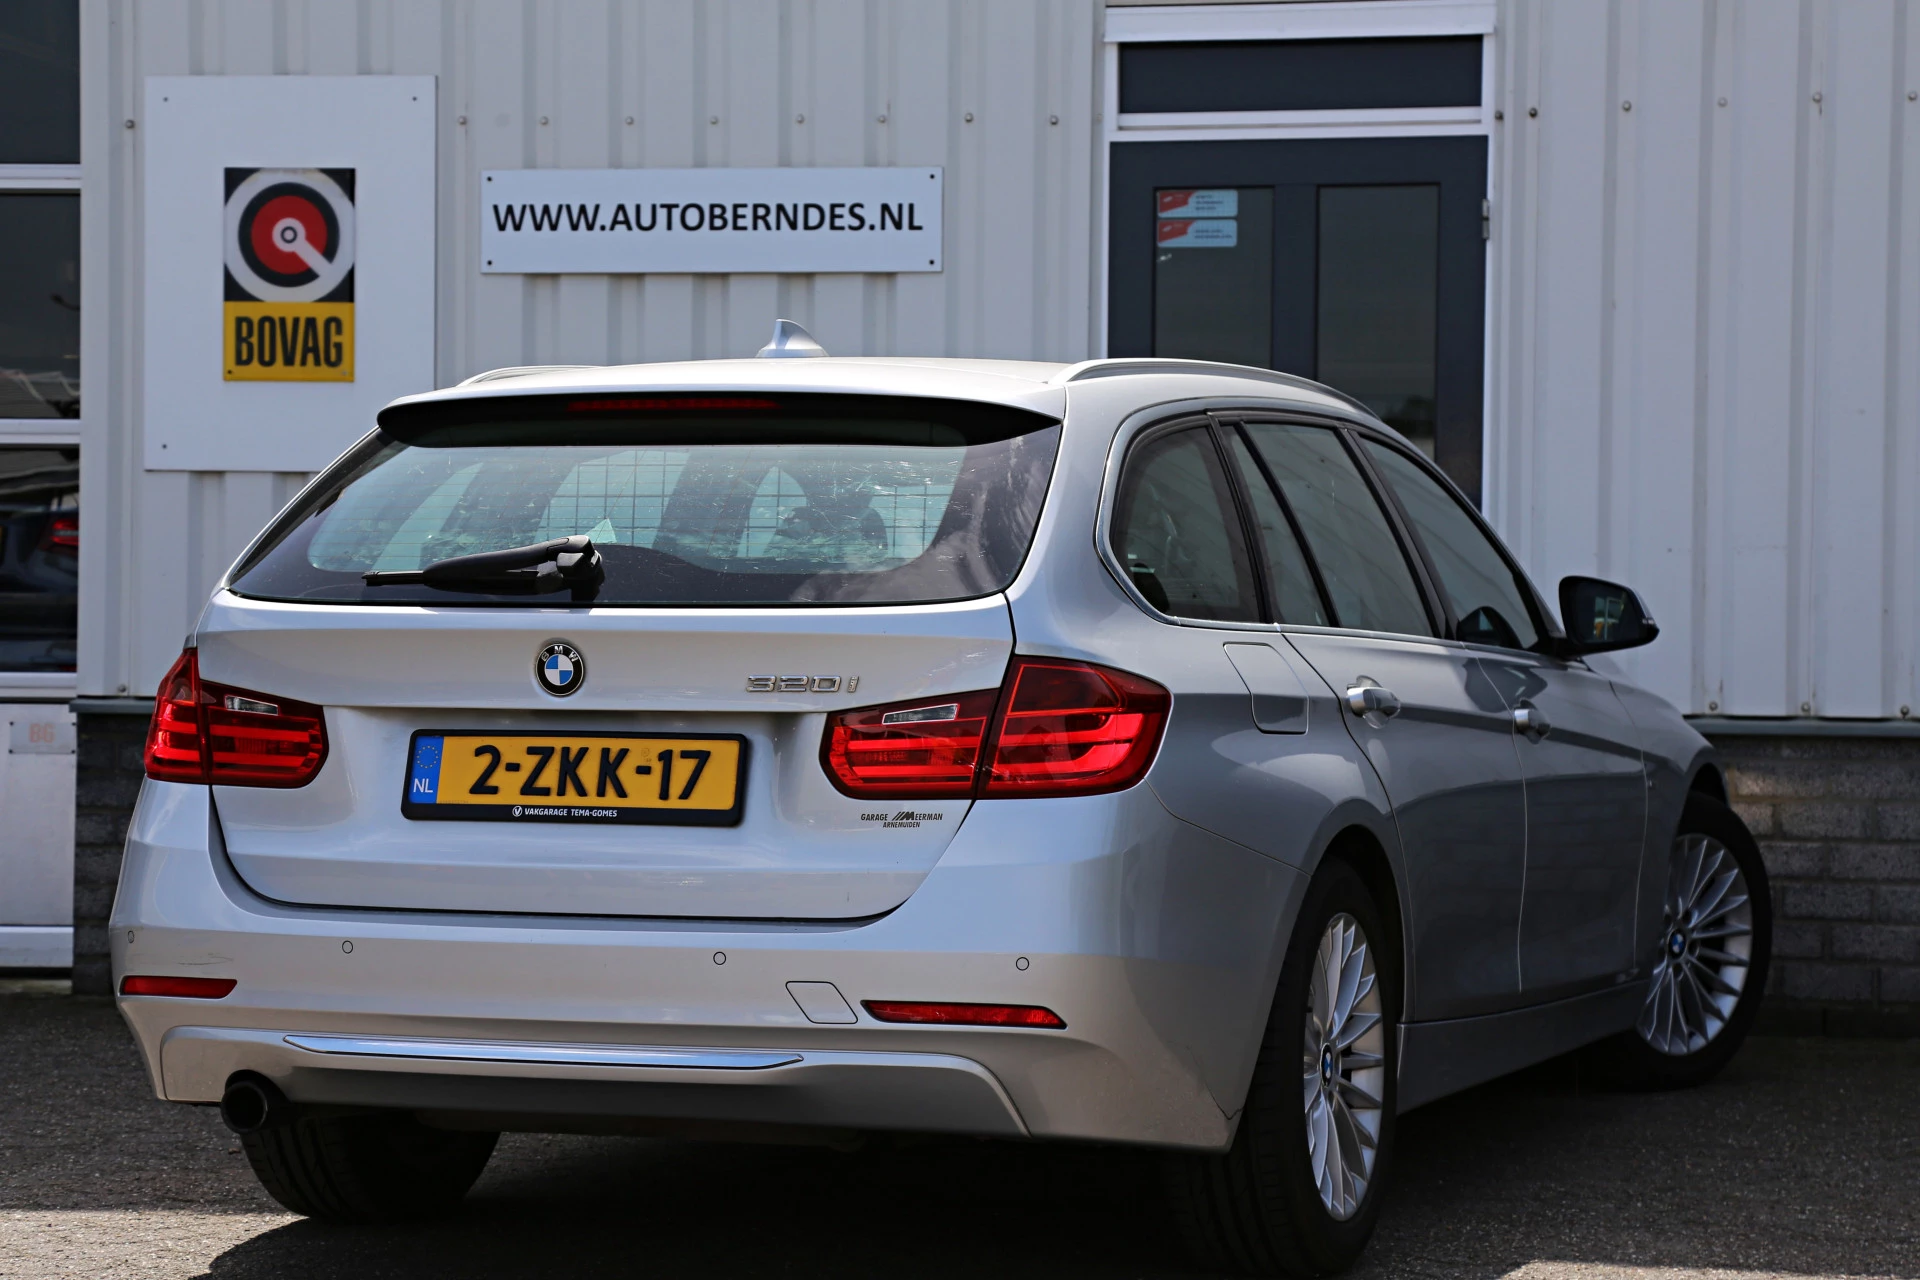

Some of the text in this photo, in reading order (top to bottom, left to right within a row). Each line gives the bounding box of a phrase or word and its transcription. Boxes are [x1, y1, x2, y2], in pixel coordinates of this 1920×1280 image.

[493, 202, 923, 231] WWW.AUTOBERNDES.NL
[234, 315, 343, 367] BOVAG
[541, 645, 579, 662] BMW
[746, 674, 859, 693] 320i
[469, 744, 711, 801] 2-ZKK-17
[413, 778, 433, 793] NL
[524, 807, 568, 816] VAKGARAGE
[571, 808, 618, 817] TEMA-GOMES
[860, 813, 889, 821] GARAGE
